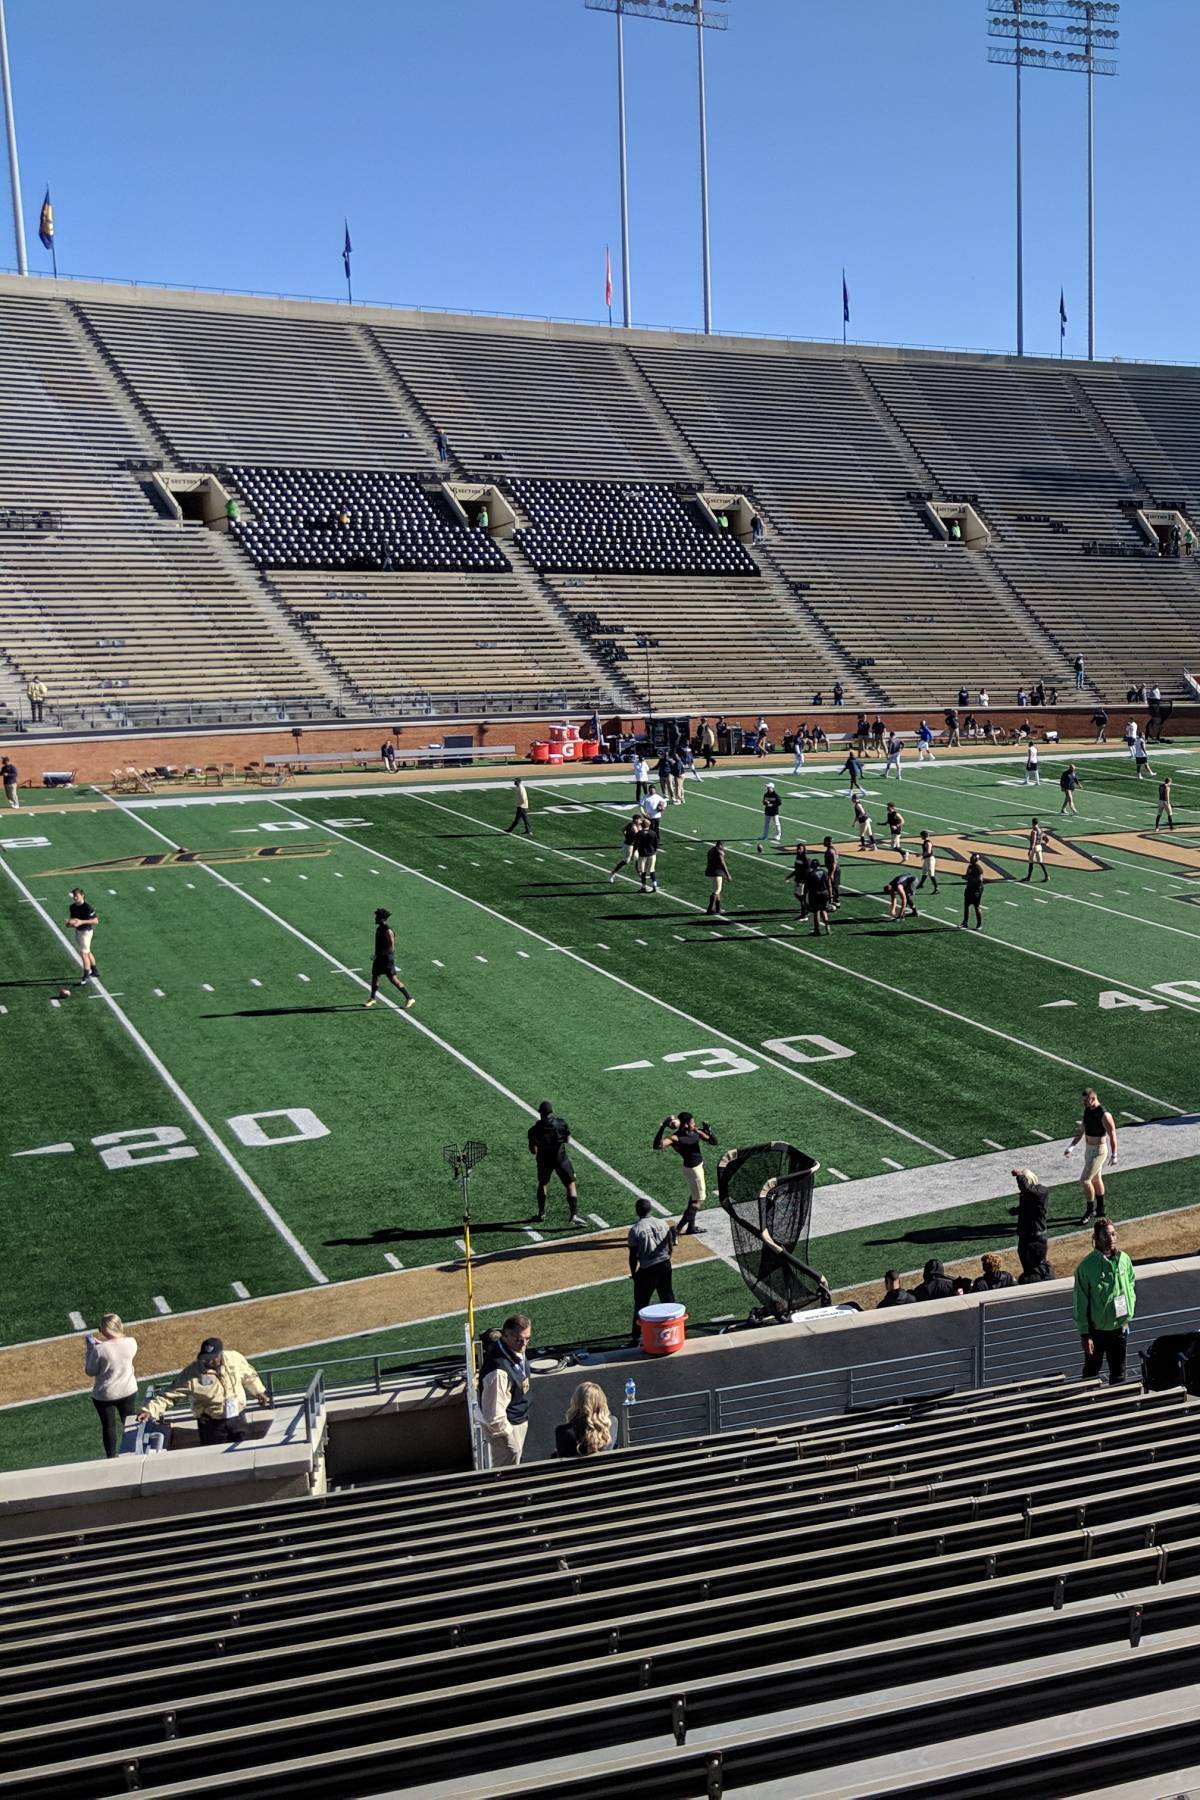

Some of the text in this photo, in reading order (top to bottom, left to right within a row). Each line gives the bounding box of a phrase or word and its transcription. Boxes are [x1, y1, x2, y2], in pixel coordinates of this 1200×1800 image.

[562, 743, 575, 758] G
[663, 1034, 857, 1078] 30
[92, 1108, 331, 1170] 20
